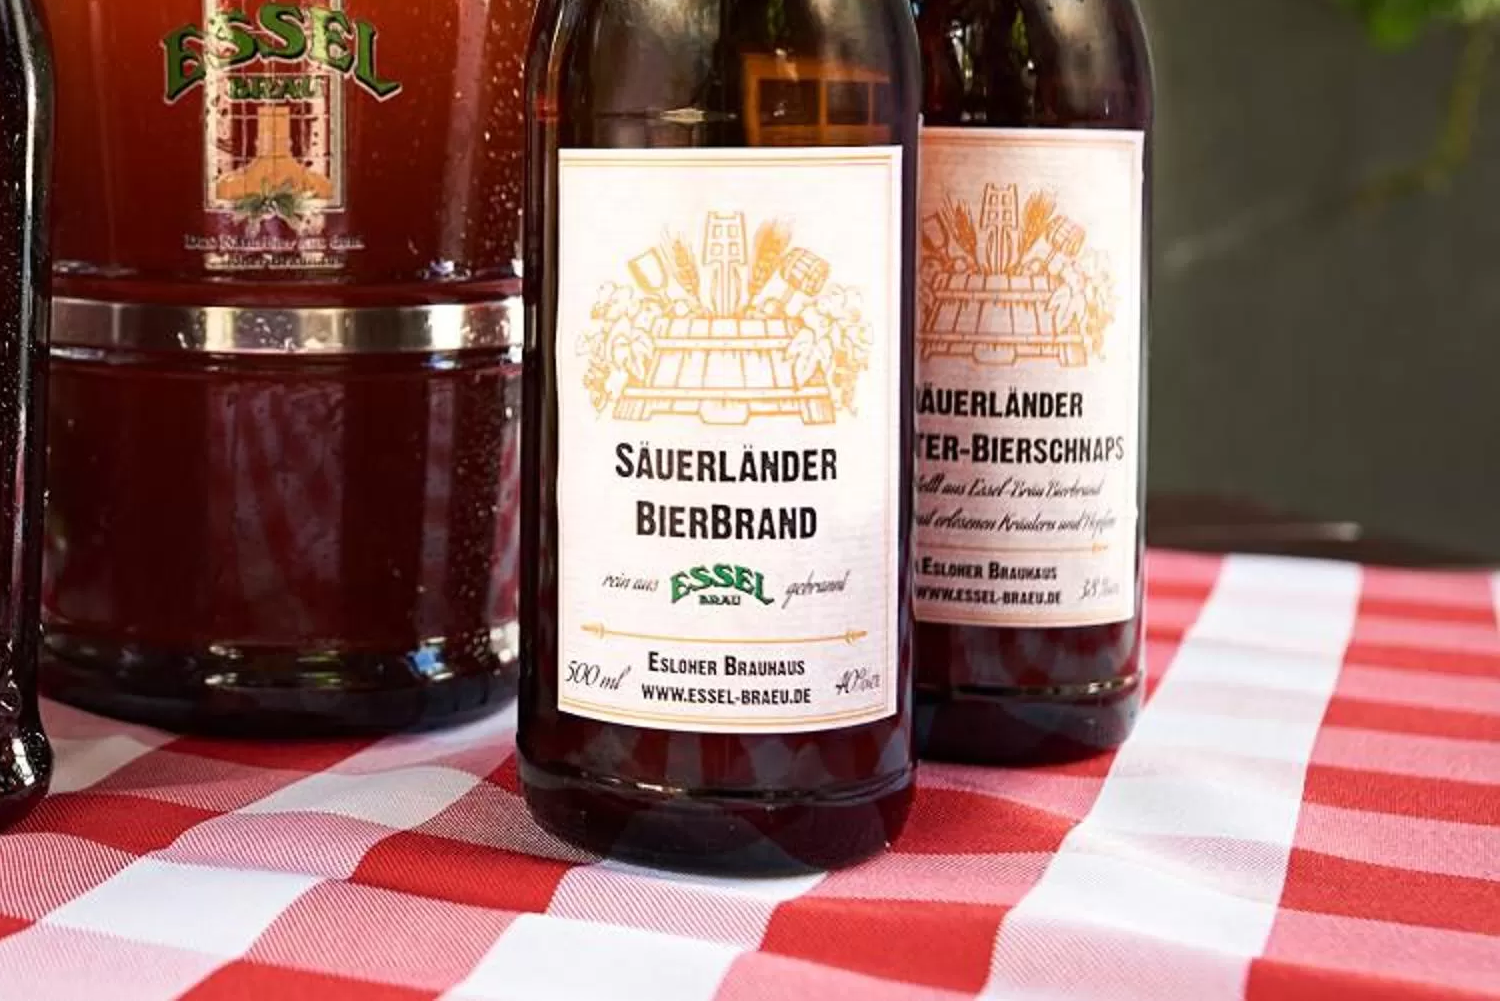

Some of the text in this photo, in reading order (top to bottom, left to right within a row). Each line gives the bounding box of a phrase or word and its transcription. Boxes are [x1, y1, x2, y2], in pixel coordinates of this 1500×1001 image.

[161, 2, 402, 104] ESSEL
[916, 381, 1084, 418] ÄUERLÄNDER
[669, 563, 775, 606] ESSEL
